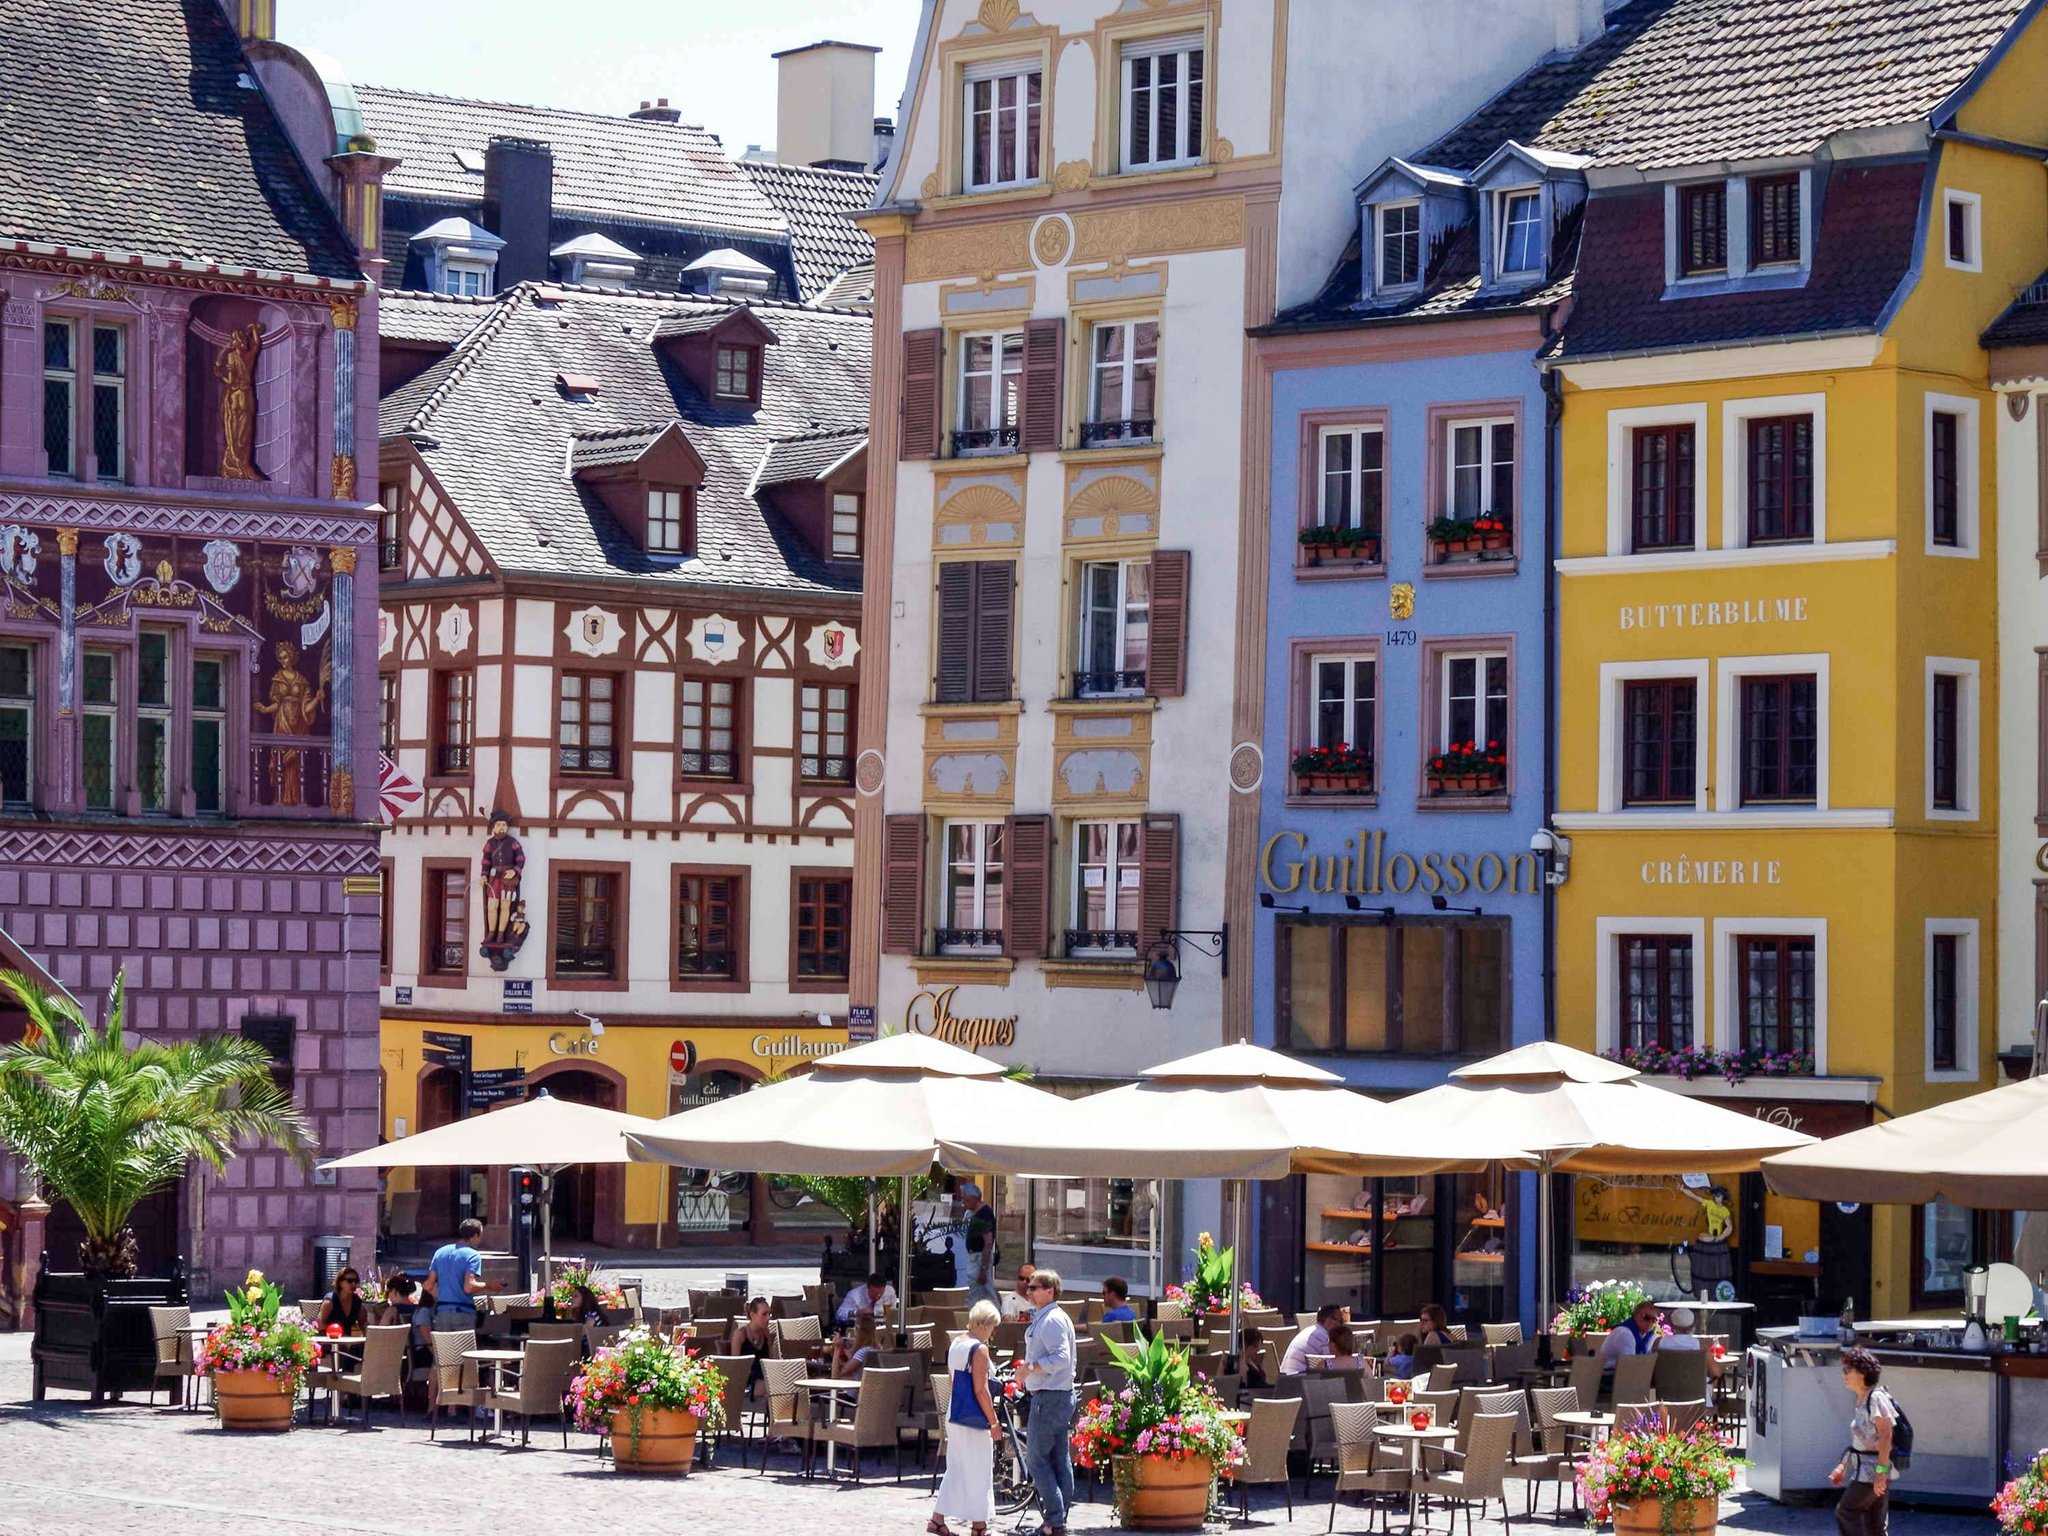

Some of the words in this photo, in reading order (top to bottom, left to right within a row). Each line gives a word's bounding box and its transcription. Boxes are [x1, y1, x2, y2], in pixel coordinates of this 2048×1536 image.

[1619, 597, 1809, 631] BUTTERBLUME
[1385, 629, 1417, 646] 1479
[1260, 828, 1540, 896] Guillosson
[1640, 854, 1781, 885] CRÊMERIE
[906, 985, 1019, 1054] Jacques
[1618, 1206, 1682, 1226] Bouton
